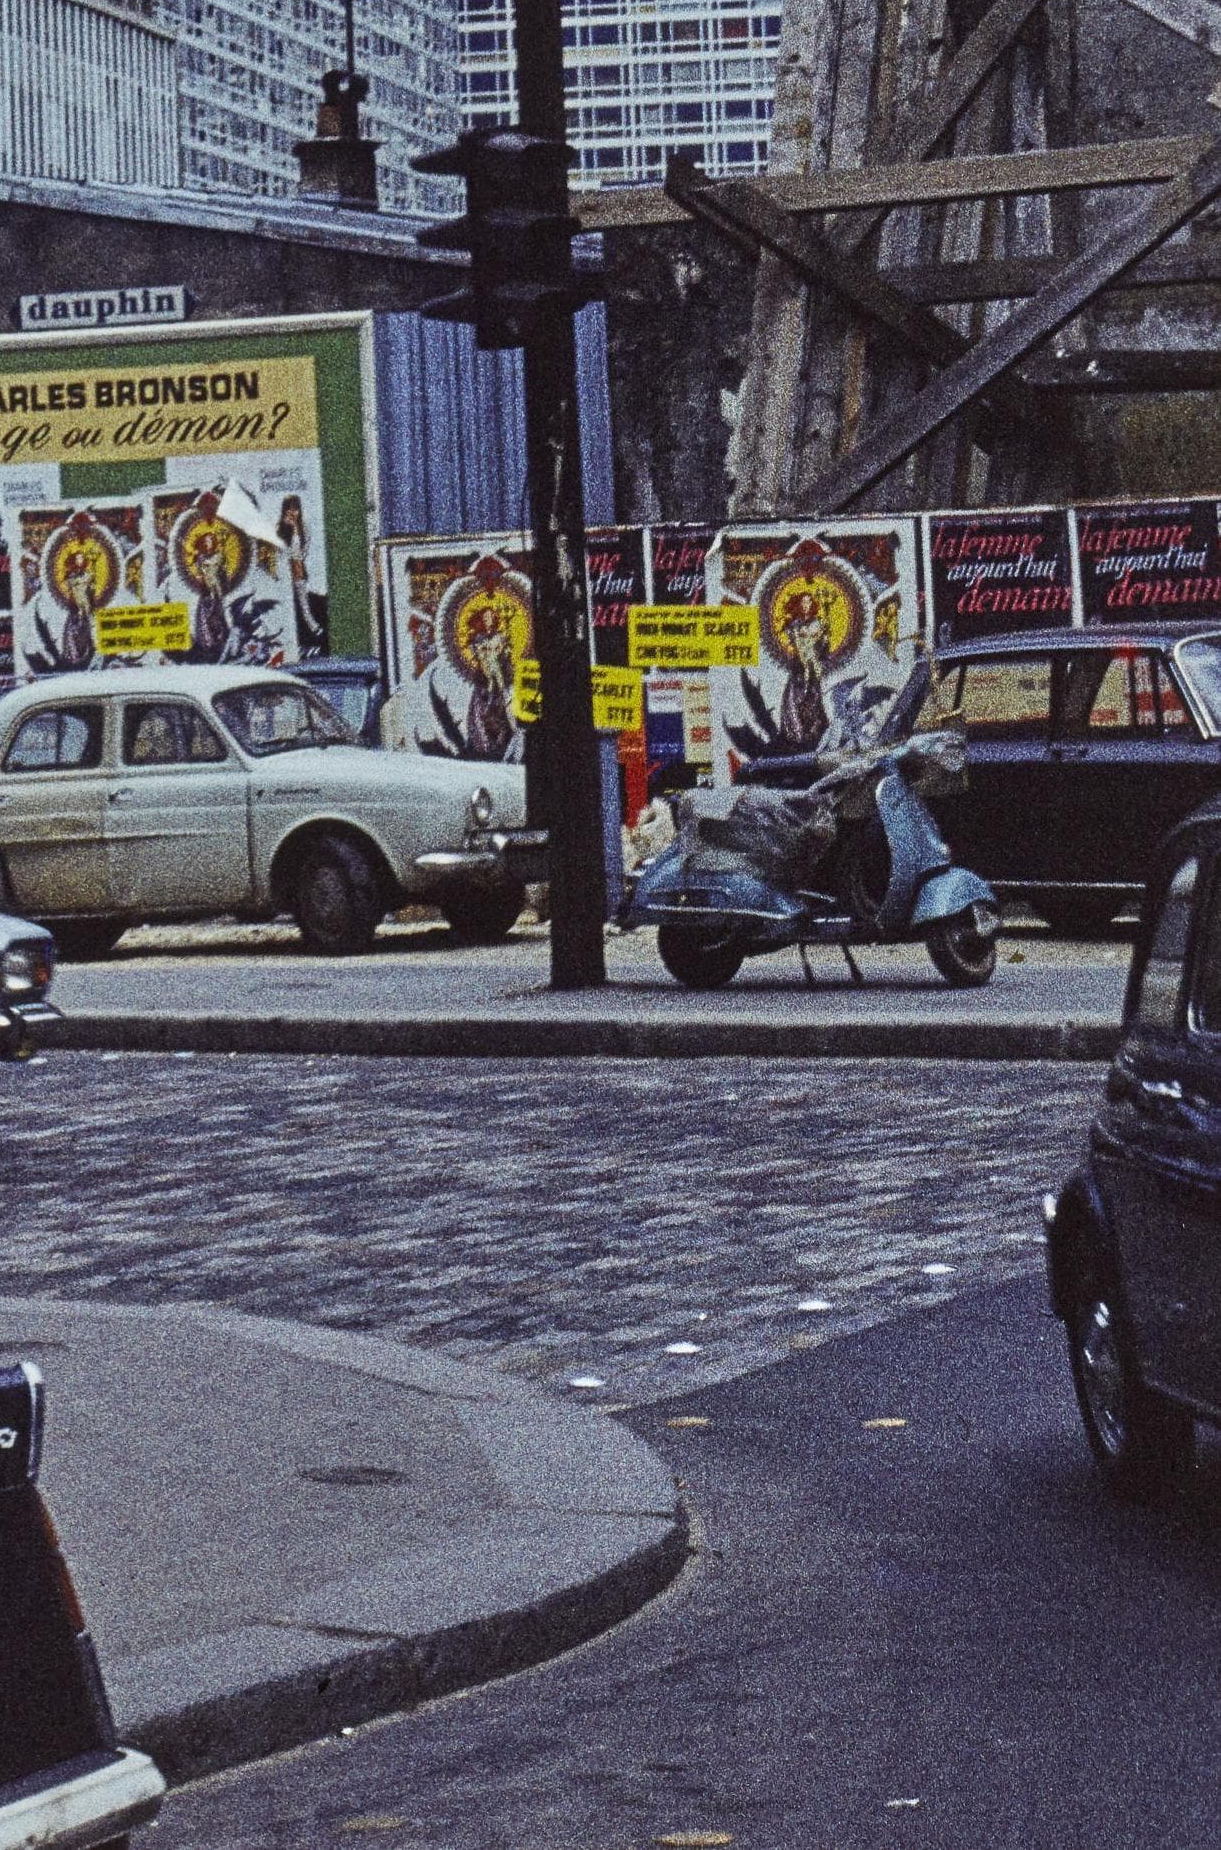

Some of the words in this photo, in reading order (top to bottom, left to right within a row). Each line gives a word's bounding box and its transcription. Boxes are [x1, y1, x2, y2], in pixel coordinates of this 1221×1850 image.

[28, 288, 176, 326] dauphin
[94, 370, 260, 409] BRONSON
[61, 425, 102, 450] ou
[113, 402, 291, 448] démon?
[932, 523, 955, 558] la
[948, 523, 1044, 566] femme
[1080, 516, 1105, 551] la
[1098, 518, 1193, 560] femme
[957, 576, 1072, 614] demain
